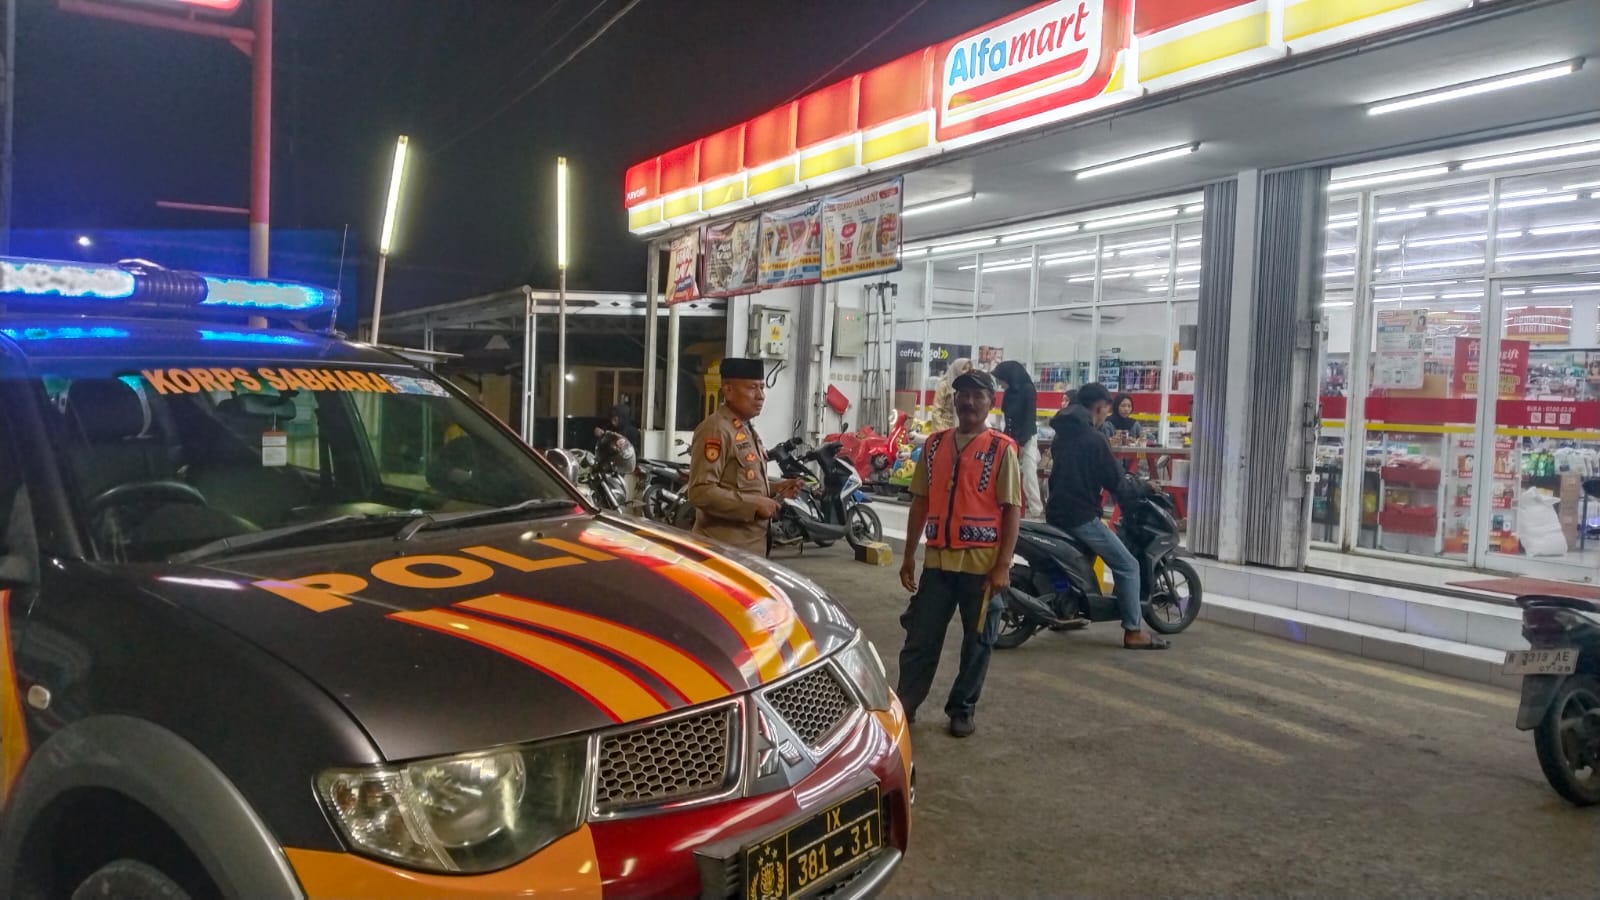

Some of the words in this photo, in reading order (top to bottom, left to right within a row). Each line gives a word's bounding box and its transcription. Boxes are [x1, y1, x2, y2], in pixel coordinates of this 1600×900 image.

[949, 2, 1089, 86] Alfamart
[1499, 347, 1520, 361] gift
[140, 367, 262, 395] KORPS
[257, 367, 398, 394] SABHARA
[250, 533, 640, 614] POLI
[826, 807, 842, 833] IX
